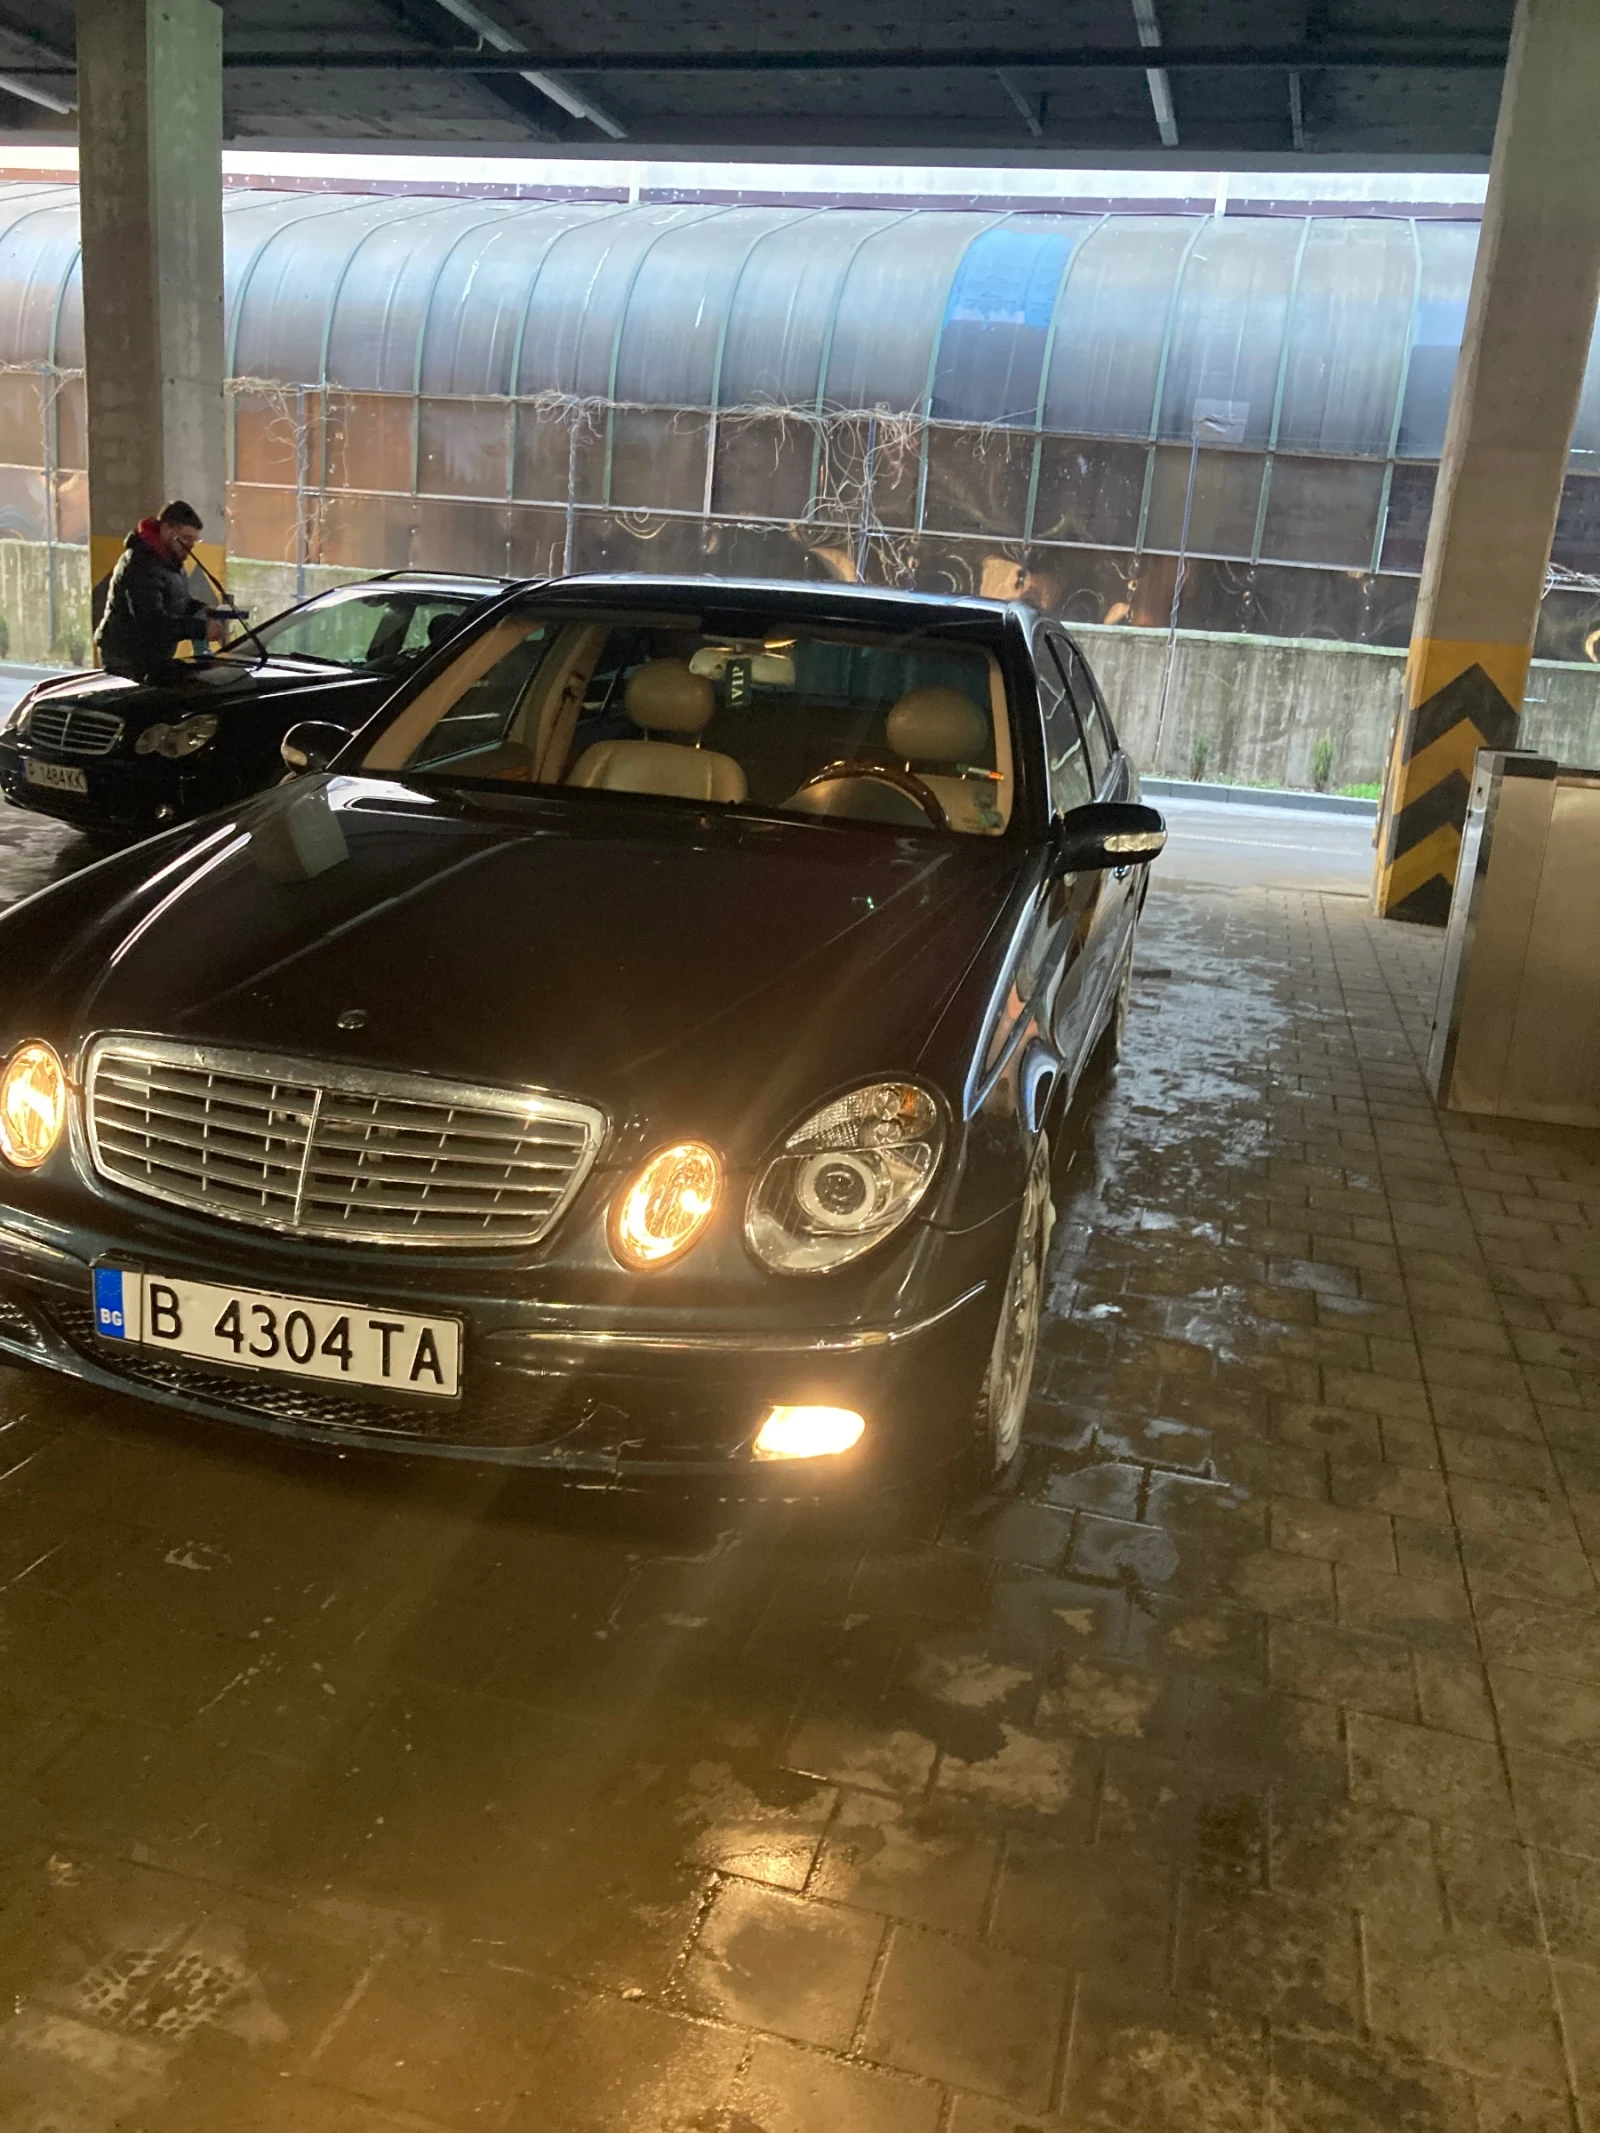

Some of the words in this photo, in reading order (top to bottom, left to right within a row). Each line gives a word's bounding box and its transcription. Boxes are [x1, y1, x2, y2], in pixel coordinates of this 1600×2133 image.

[731, 666, 744, 700] VIP
[100, 1308, 123, 1327] BG
[149, 1283, 183, 1340] B
[214, 1298, 353, 1372] 4304
[368, 1320, 445, 1385] TA
